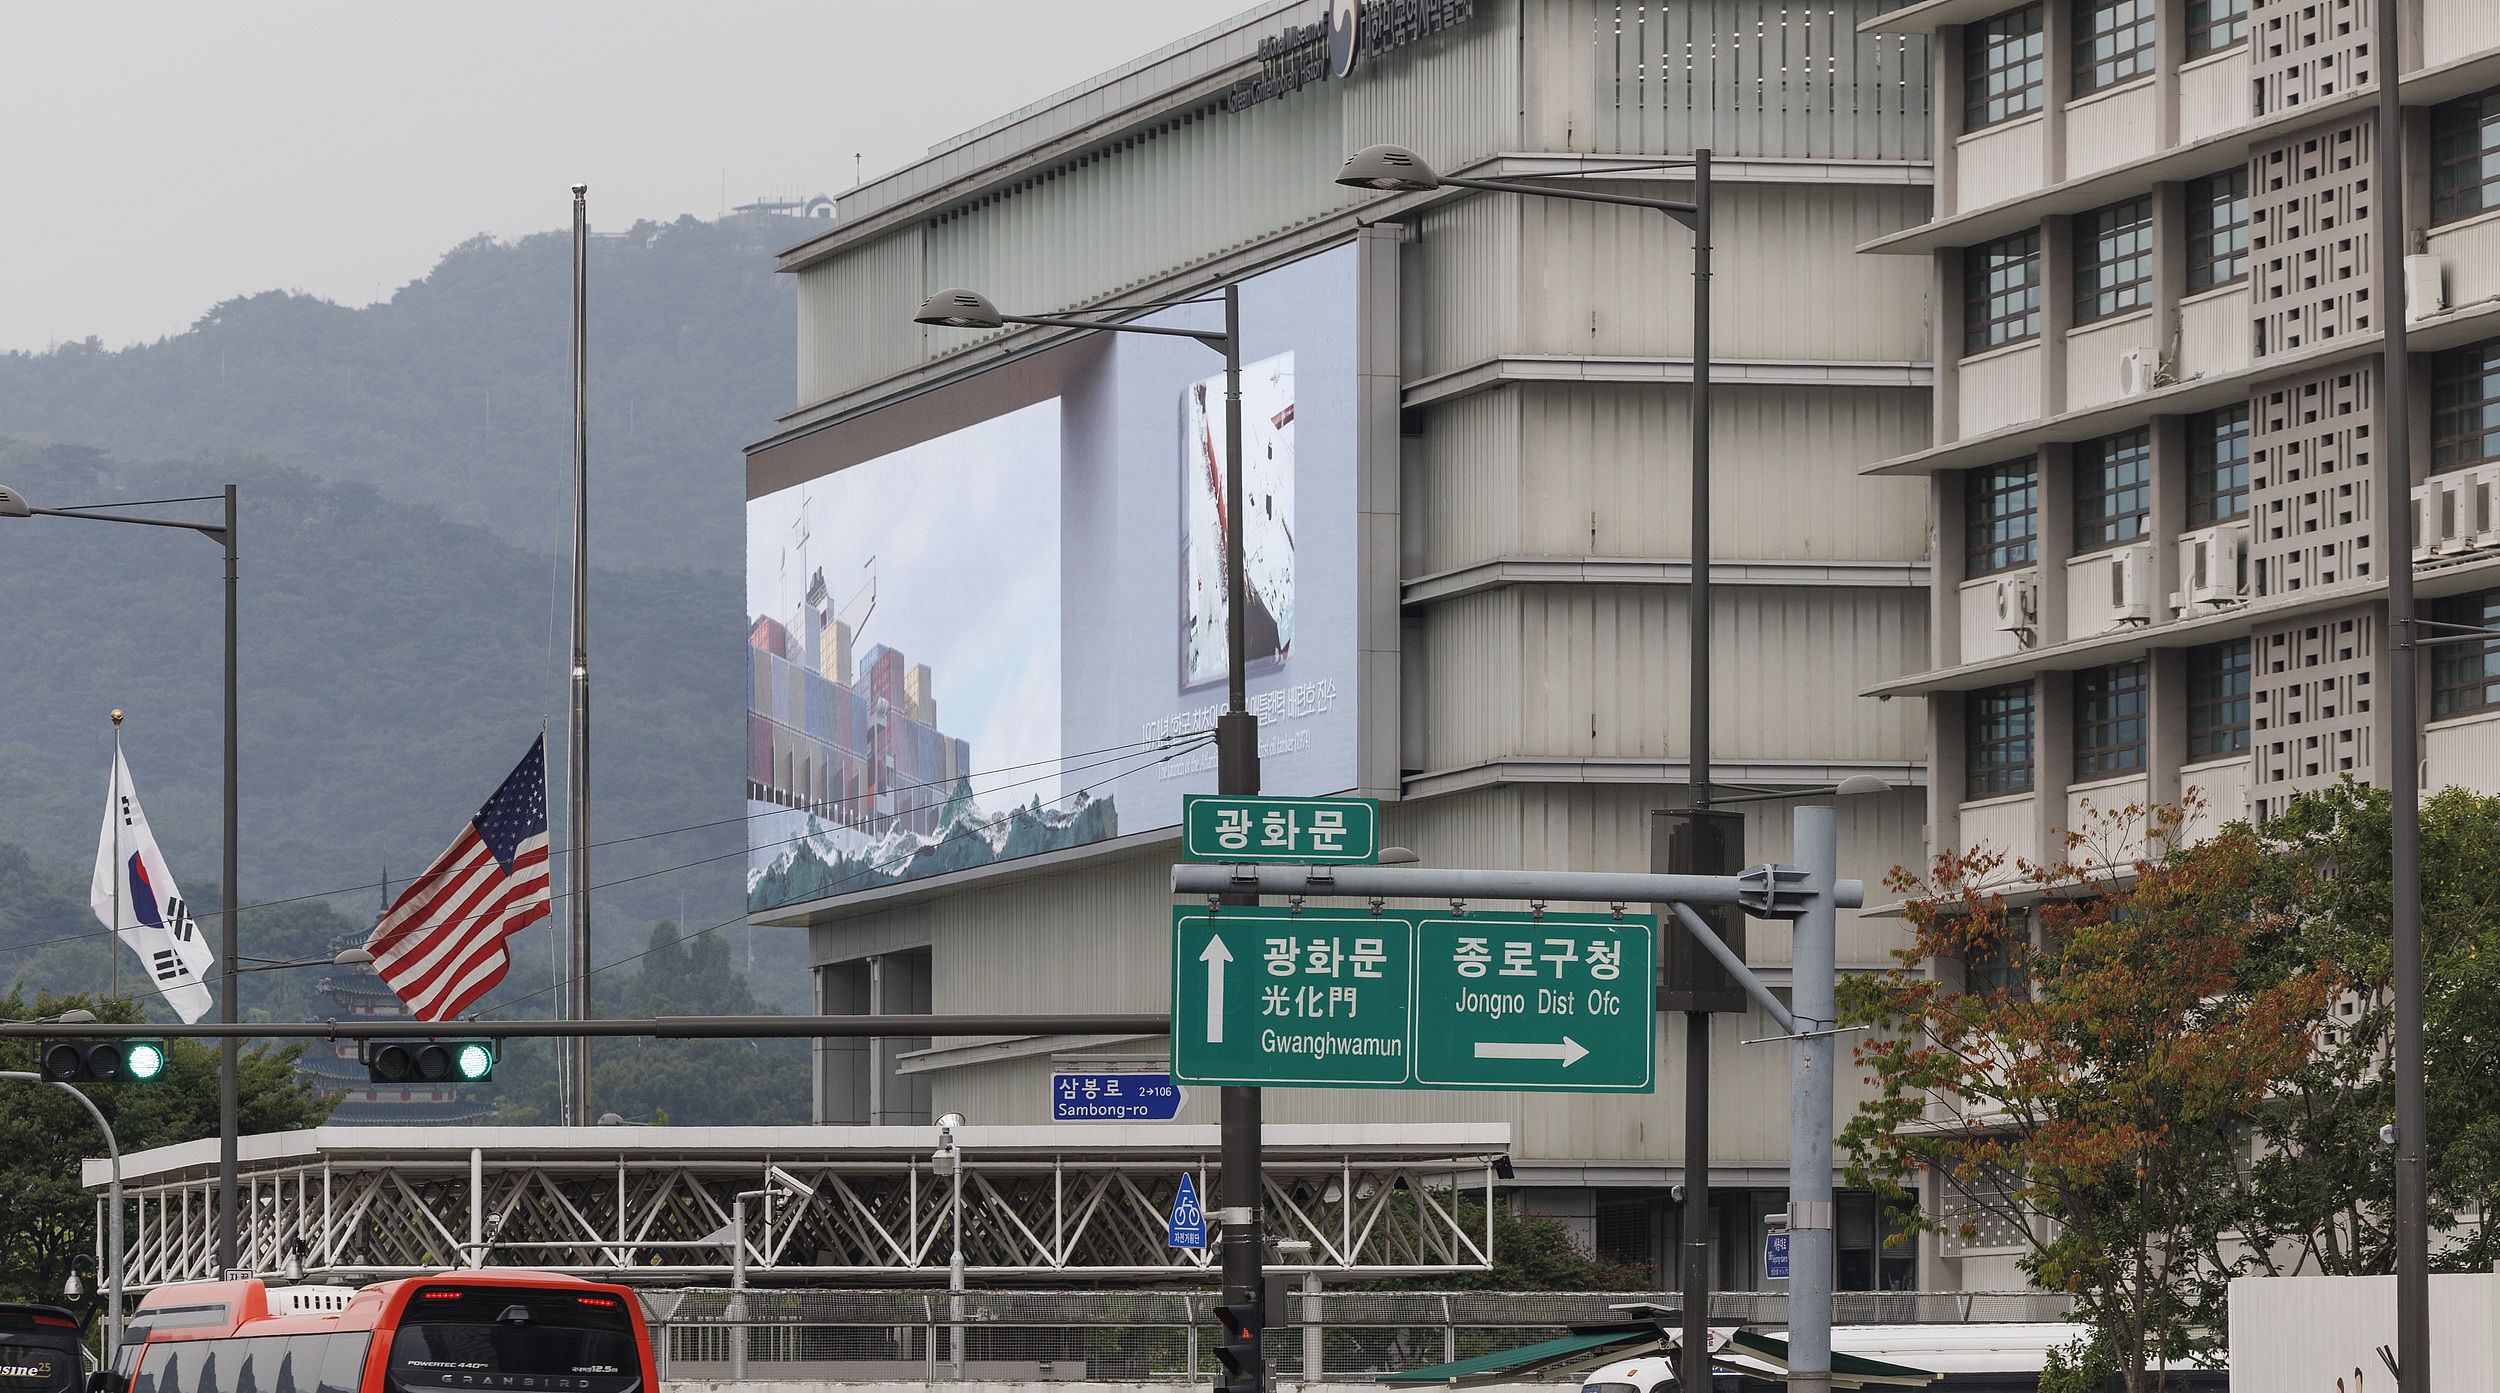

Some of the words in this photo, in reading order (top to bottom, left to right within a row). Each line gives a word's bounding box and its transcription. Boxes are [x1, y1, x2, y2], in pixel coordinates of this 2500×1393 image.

[1258, 34, 1285, 62] National
[1284, 24, 1316, 51] Museum
[1228, 89, 1252, 114] Korean
[1251, 69, 1302, 102] Contemporary
[1301, 58, 1327, 85] History
[1215, 808, 1348, 852] 광화문
[1262, 936, 1388, 979] 광화문
[1452, 936, 1622, 980] 종로구청
[1261, 985, 1358, 1018] 光化門
[1455, 987, 1525, 1020] Jongno
[1538, 988, 1575, 1016] Dist
[1587, 988, 1621, 1017] Ofc
[1260, 1028, 1402, 1061] Gwanghwamun
[1058, 1078, 1123, 1100] 삼봉로
[1058, 1103, 1148, 1118] Sambong-ro
[1174, 1232, 1200, 1245] 자전거횡단
[0, 1365, 39, 1376] sine
[38, 1362, 52, 1372] 25
[407, 1360, 457, 1368] POWERTEC
[441, 1374, 590, 1388] GRANBIRD
